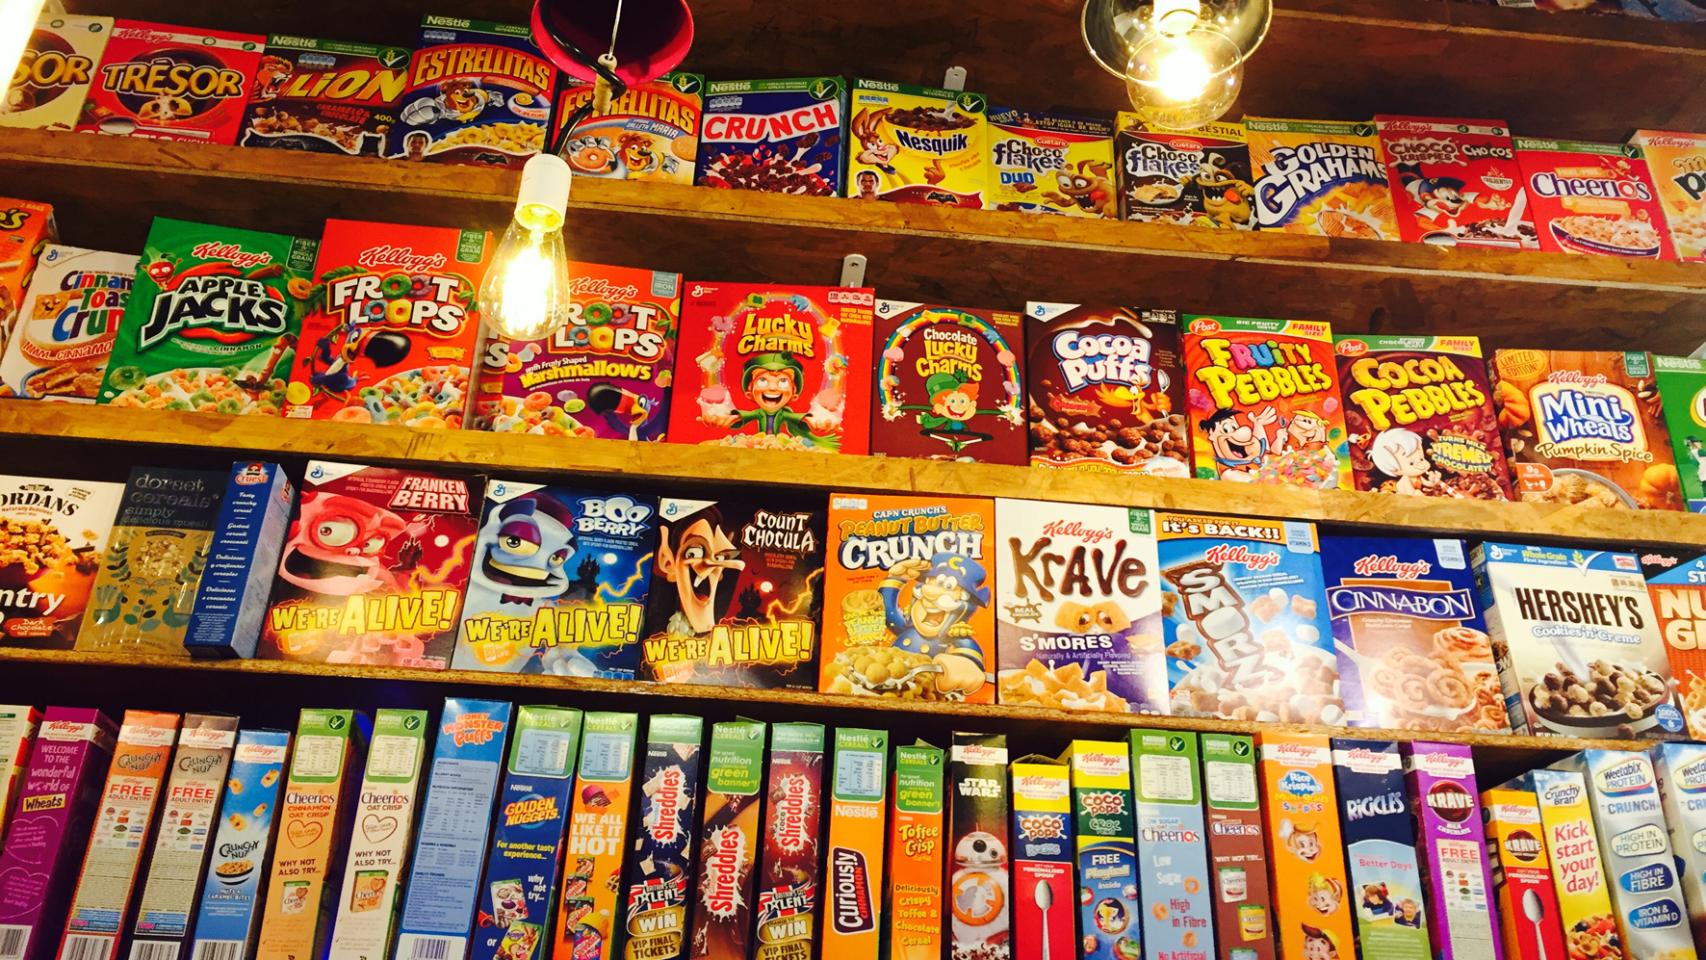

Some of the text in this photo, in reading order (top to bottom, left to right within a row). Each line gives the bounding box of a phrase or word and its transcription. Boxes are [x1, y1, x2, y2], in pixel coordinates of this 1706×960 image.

[272, 36, 317, 48] Nestlé
[413, 47, 550, 91] ESTRELLITAS
[104, 58, 243, 98] TRÉSOR
[859, 80, 899, 92] Nestlé
[710, 82, 752, 93] Nestlé
[704, 105, 838, 140] CRUNCH
[1198, 125, 1243, 137] BESTIAL
[896, 130, 968, 156] Nesquik
[1264, 142, 1375, 175] GOLDEN
[1000, 172, 1035, 184] DUO
[1530, 171, 1651, 201] Cheerios
[193, 241, 273, 268] Kellogg's
[359, 245, 446, 271] Kellogg's
[178, 277, 262, 298] APPLE
[334, 274, 459, 307] FROOT
[140, 291, 285, 345] JACKS
[348, 298, 466, 331] LOOPS
[742, 313, 815, 345] Lucky
[1292, 323, 1327, 332] FAMILY
[555, 325, 664, 358] LOOPS
[923, 328, 978, 346] Chocolate
[737, 334, 815, 358] Charms
[924, 340, 978, 365] Lucky
[1054, 331, 1151, 361] Cocoa
[519, 360, 652, 389] Marshmallows
[1060, 355, 1151, 392] Puffs
[1350, 356, 1466, 390] COCOA
[1548, 370, 1607, 387] Kellogg's
[1195, 362, 1332, 410] PEBBLES
[1351, 379, 1487, 430] PEBBLES
[1542, 390, 1623, 421] Mini
[1545, 412, 1632, 443] Wheats
[1535, 442, 1654, 463] Pumpkin Spice
[400, 476, 467, 495] FRANKEN
[390, 490, 468, 511] BERRY
[580, 496, 650, 522] BOO
[575, 517, 643, 537] BERRY
[840, 513, 984, 541] PEANUT BUTTER
[1043, 520, 1114, 543] Kellogg's
[841, 531, 984, 569] CRUNCH
[1206, 544, 1280, 570] Kellogg's
[1354, 555, 1430, 580] Kellogg's
[1331, 590, 1470, 616] CINNABON
[1514, 587, 1645, 630] HERSHEY'S
[271, 606, 338, 632] WE'RE
[338, 591, 458, 635] ALIVE!
[465, 604, 645, 647] WE'RE ALIVE!
[645, 620, 815, 666] WE'RE ALIVE!
[1019, 633, 1113, 651] S'MORES
[443, 720, 503, 735] MONSTER
[41, 745, 79, 755] WELCOME
[900, 752, 928, 760] Nestlé
[44, 755, 70, 764] TO THE
[711, 756, 752, 766] nutrition
[711, 768, 749, 779] green
[1290, 771, 1312, 783] Rice
[1603, 762, 1642, 780] Weetabix
[110, 784, 154, 797] FREE
[899, 779, 935, 788] nutrition
[962, 778, 997, 788] STAR
[1606, 775, 1646, 789] PROTEIN
[172, 786, 215, 799] FREE
[286, 792, 335, 804] Cheerios
[361, 792, 409, 804] Cheerios
[899, 790, 933, 800] green
[958, 786, 1001, 798] WARS
[1083, 795, 1122, 806] COCO
[1426, 792, 1475, 809] KRAVE
[1545, 784, 1581, 802] Crunchy
[1553, 794, 1576, 806] Bran
[24, 797, 62, 810] Wheats
[653, 771, 681, 842] Shreddies
[778, 777, 804, 847] Shreddies
[1607, 801, 1657, 814] CRUNCH
[574, 814, 623, 825] WE ALL
[1021, 818, 1062, 830] COCO
[571, 825, 623, 837] LIKE IT
[898, 824, 939, 841] Toffee
[1142, 827, 1200, 842] Cheerios
[1554, 824, 1590, 843] Kick
[1620, 830, 1657, 843] HIGH IN
[354, 850, 373, 858] WHY
[496, 840, 555, 854] For another tasty
[570, 838, 622, 856] HOT
[905, 839, 935, 857] Crisp
[1441, 847, 1479, 859] FREE
[1556, 840, 1595, 859] start
[1616, 838, 1664, 853] PROTEIN
[1092, 854, 1121, 865] FREE
[1359, 859, 1412, 871] Better Days
[711, 830, 740, 913] Shreddies
[1560, 858, 1597, 879] your
[1631, 867, 1665, 881] HIGH IN
[528, 874, 545, 885] why
[533, 883, 547, 892] not
[1097, 881, 1122, 889] inside
[1631, 875, 1665, 892] FIBRE
[895, 884, 939, 895] Deliciously
[898, 895, 932, 907] Crispy
[1170, 899, 1191, 913] High
[898, 908, 938, 919] Toffee &
[1638, 903, 1670, 917] IRON &
[638, 913, 678, 934] WIN
[1172, 916, 1207, 928] in Fibre
[1633, 912, 1679, 928] VITAMIN D
[768, 922, 806, 941] WIN
[487, 938, 497, 947] or
[632, 933, 675, 950] VIP FINAL
[901, 935, 932, 947] Cereal
[762, 943, 804, 957] VIP FINAL
